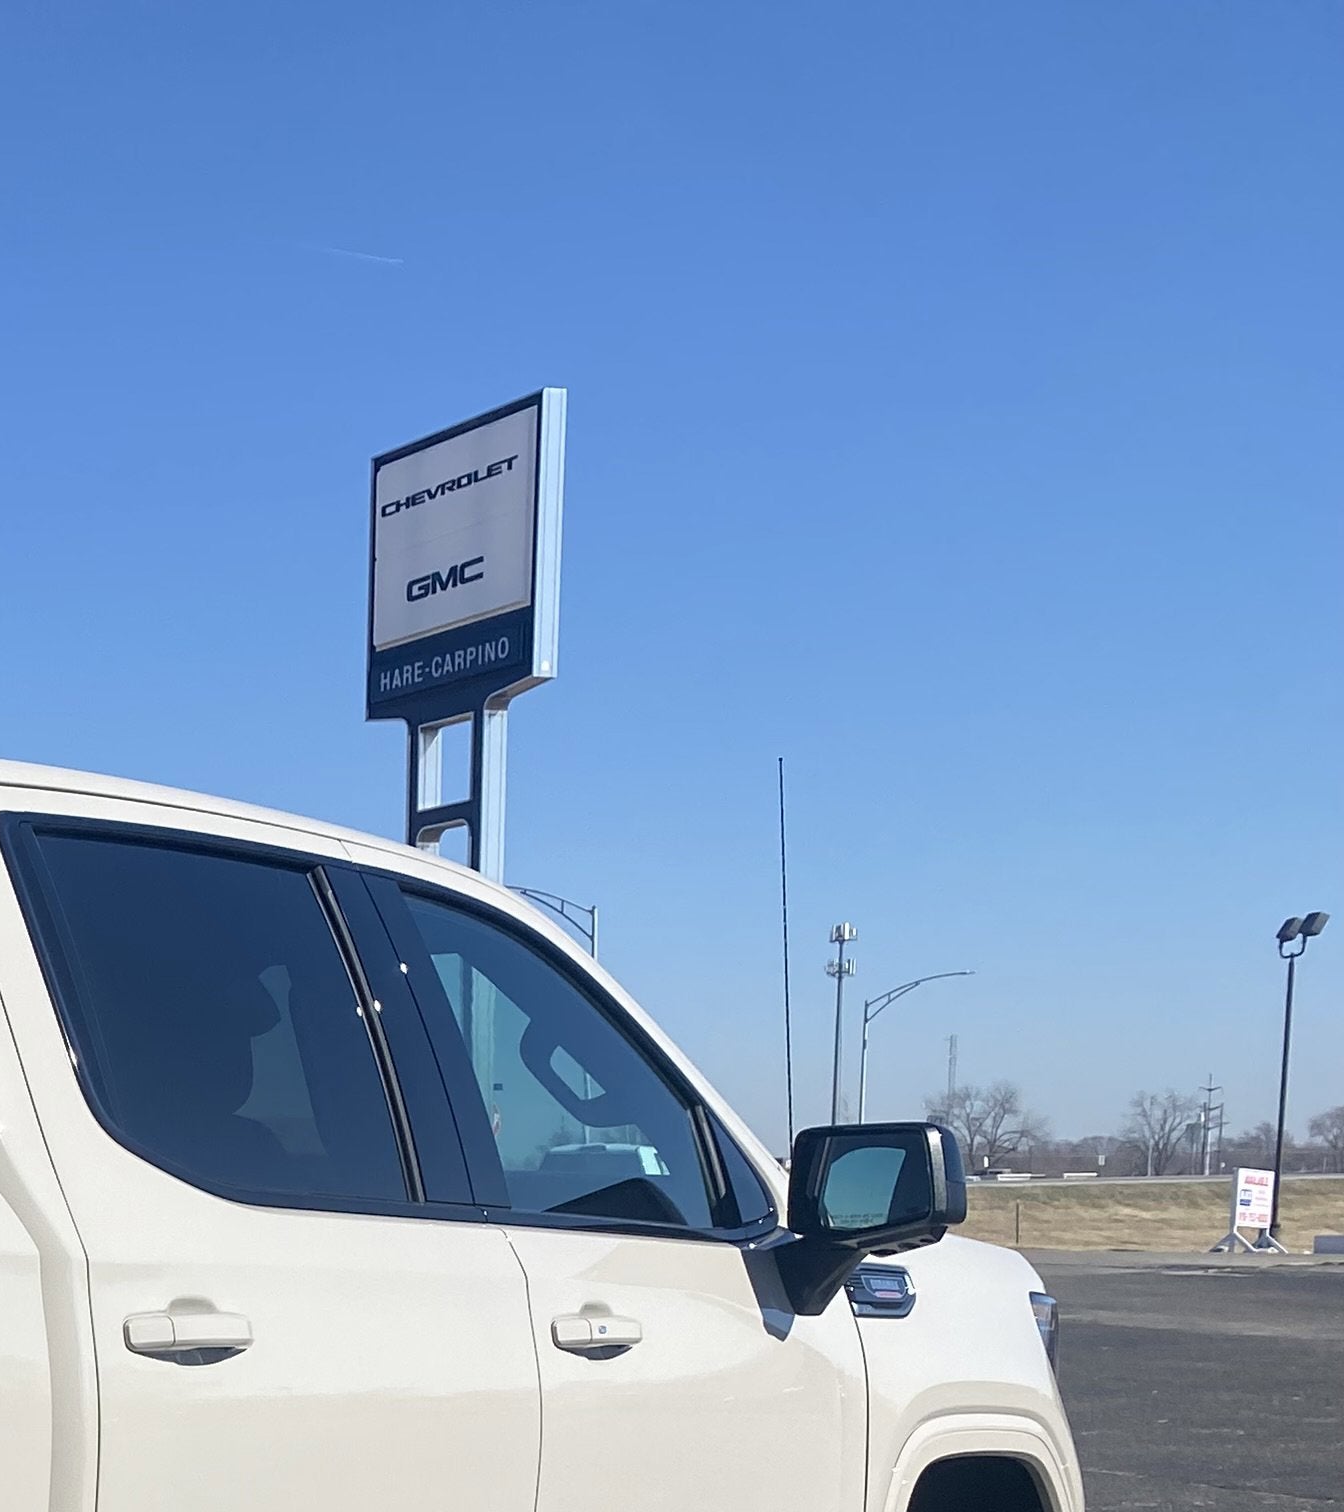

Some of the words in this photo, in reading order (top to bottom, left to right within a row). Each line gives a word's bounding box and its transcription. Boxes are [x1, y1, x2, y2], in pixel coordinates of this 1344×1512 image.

[381, 454, 519, 518] CHEVROLET
[406, 556, 485, 602] GMC
[379, 636, 510, 693] HARE-CARPINO
